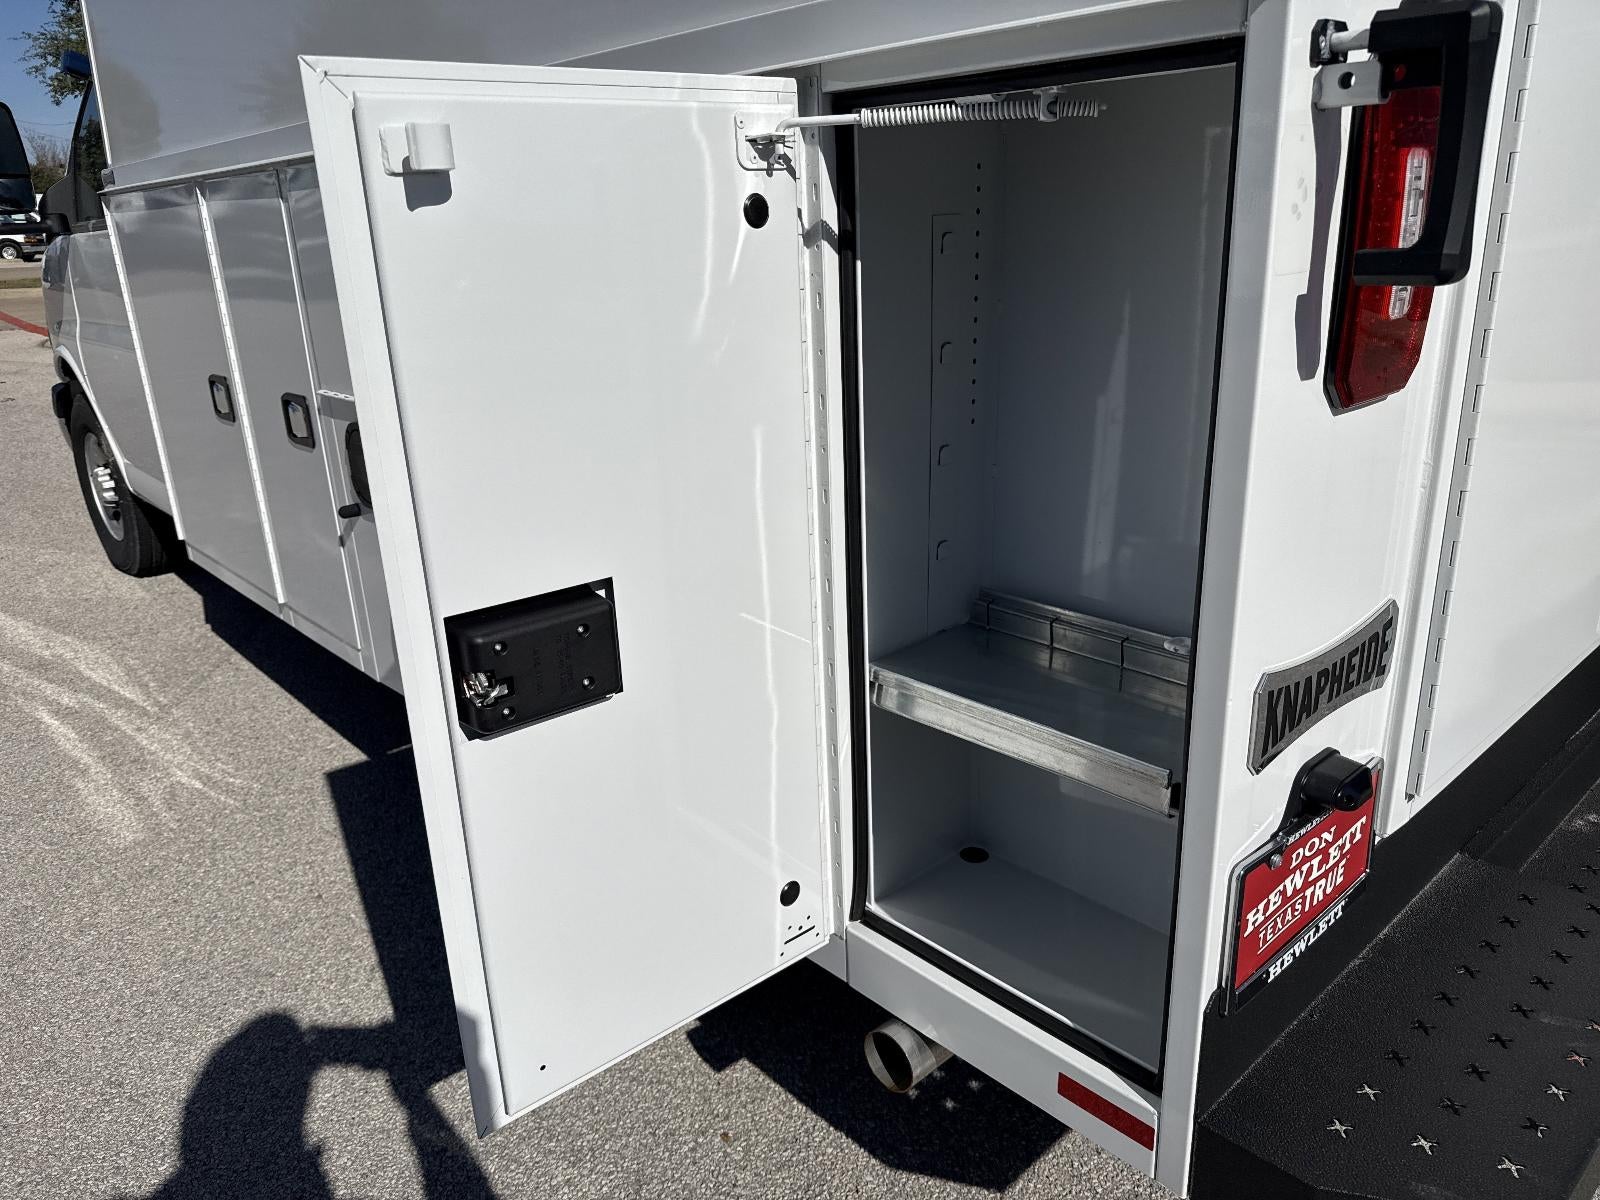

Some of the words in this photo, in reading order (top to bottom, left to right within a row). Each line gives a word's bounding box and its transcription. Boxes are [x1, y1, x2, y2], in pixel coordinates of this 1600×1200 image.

[1260, 616, 1393, 759] KNAPHEIDE
[1243, 816, 1367, 937] HEWLETT
[1289, 824, 1337, 870] DON
[1267, 904, 1346, 983] HEWLETT
